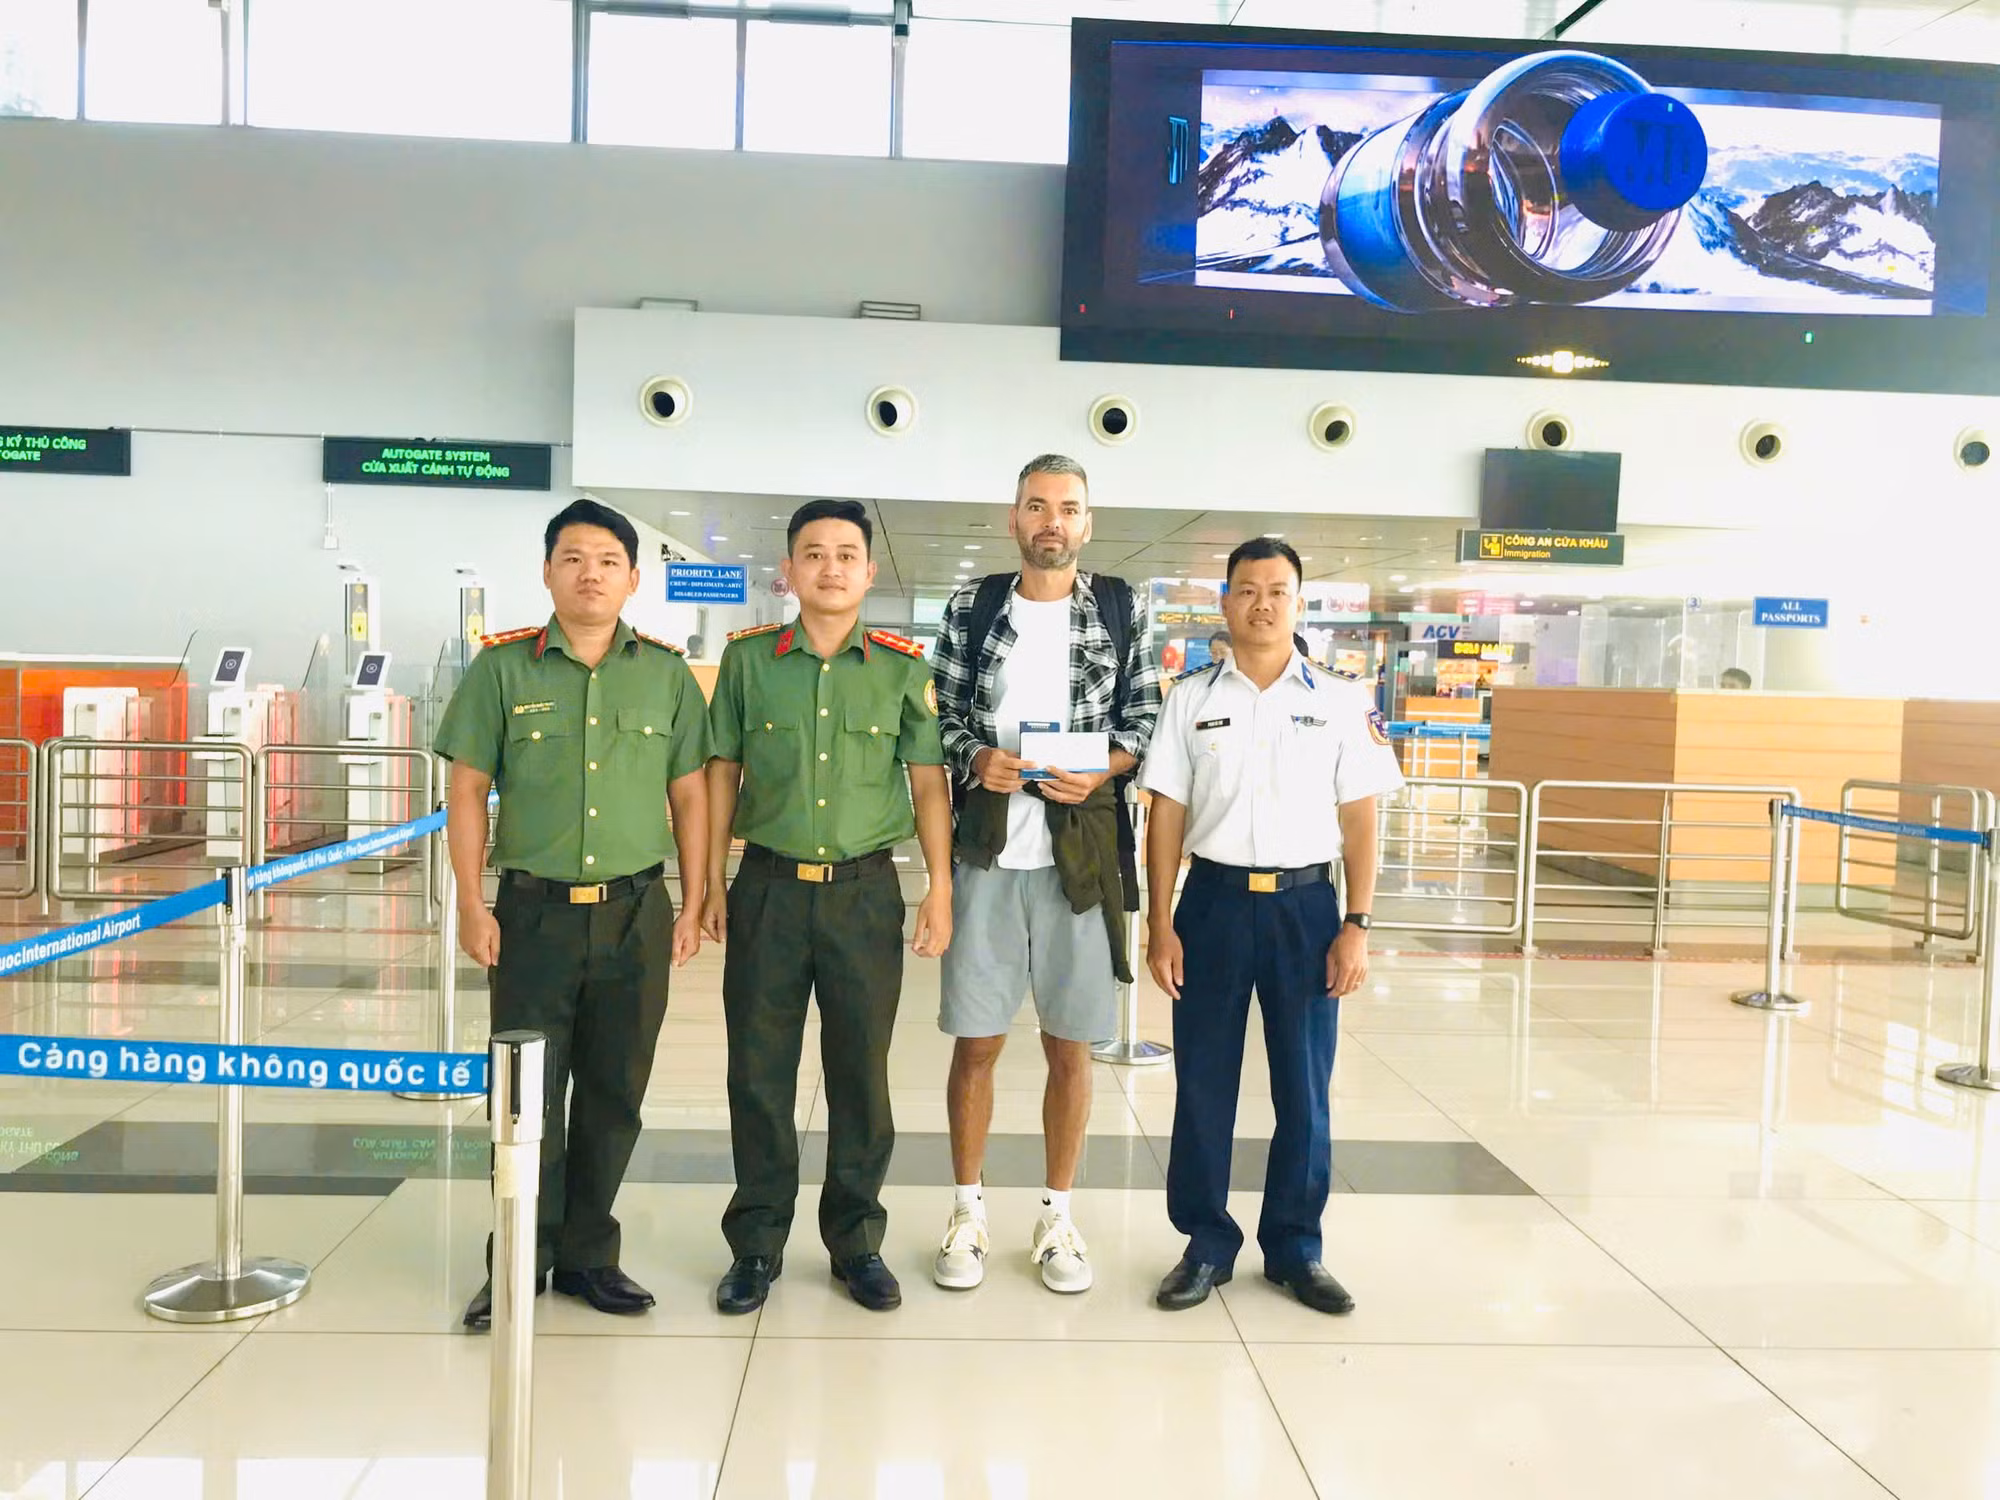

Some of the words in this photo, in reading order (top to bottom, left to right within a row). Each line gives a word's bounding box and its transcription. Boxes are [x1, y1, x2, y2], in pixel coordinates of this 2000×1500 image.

[6, 434, 22, 447] KÝ
[25, 435, 49, 449] THỦ
[52, 436, 87, 450] CÔNG
[0, 450, 41, 461] OGATE
[382, 448, 443, 461] AUTOGATE
[445, 451, 490, 462] SYSTEM
[362, 460, 386, 473] CỬA
[388, 461, 418, 475] XUẤT
[476, 464, 510, 478] ĐỘNG
[1505, 534, 1536, 547] CÔNG
[1537, 537, 1552, 547] AN
[1554, 536, 1577, 548] CỬA
[1504, 549, 1551, 559] Immigration
[671, 568, 714, 577] PRIORITY
[718, 570, 743, 578] LANE
[1780, 601, 1802, 611] ALL
[1761, 613, 1821, 624] PASSPORTS
[1423, 624, 1460, 639] ACV
[102, 911, 141, 940] Airport
[18, 1042, 108, 1078] Cảng
[119, 1046, 206, 1083] hàng
[217, 1050, 328, 1088] không
[339, 1056, 425, 1089] quốc
[438, 1058, 472, 1087] tế
